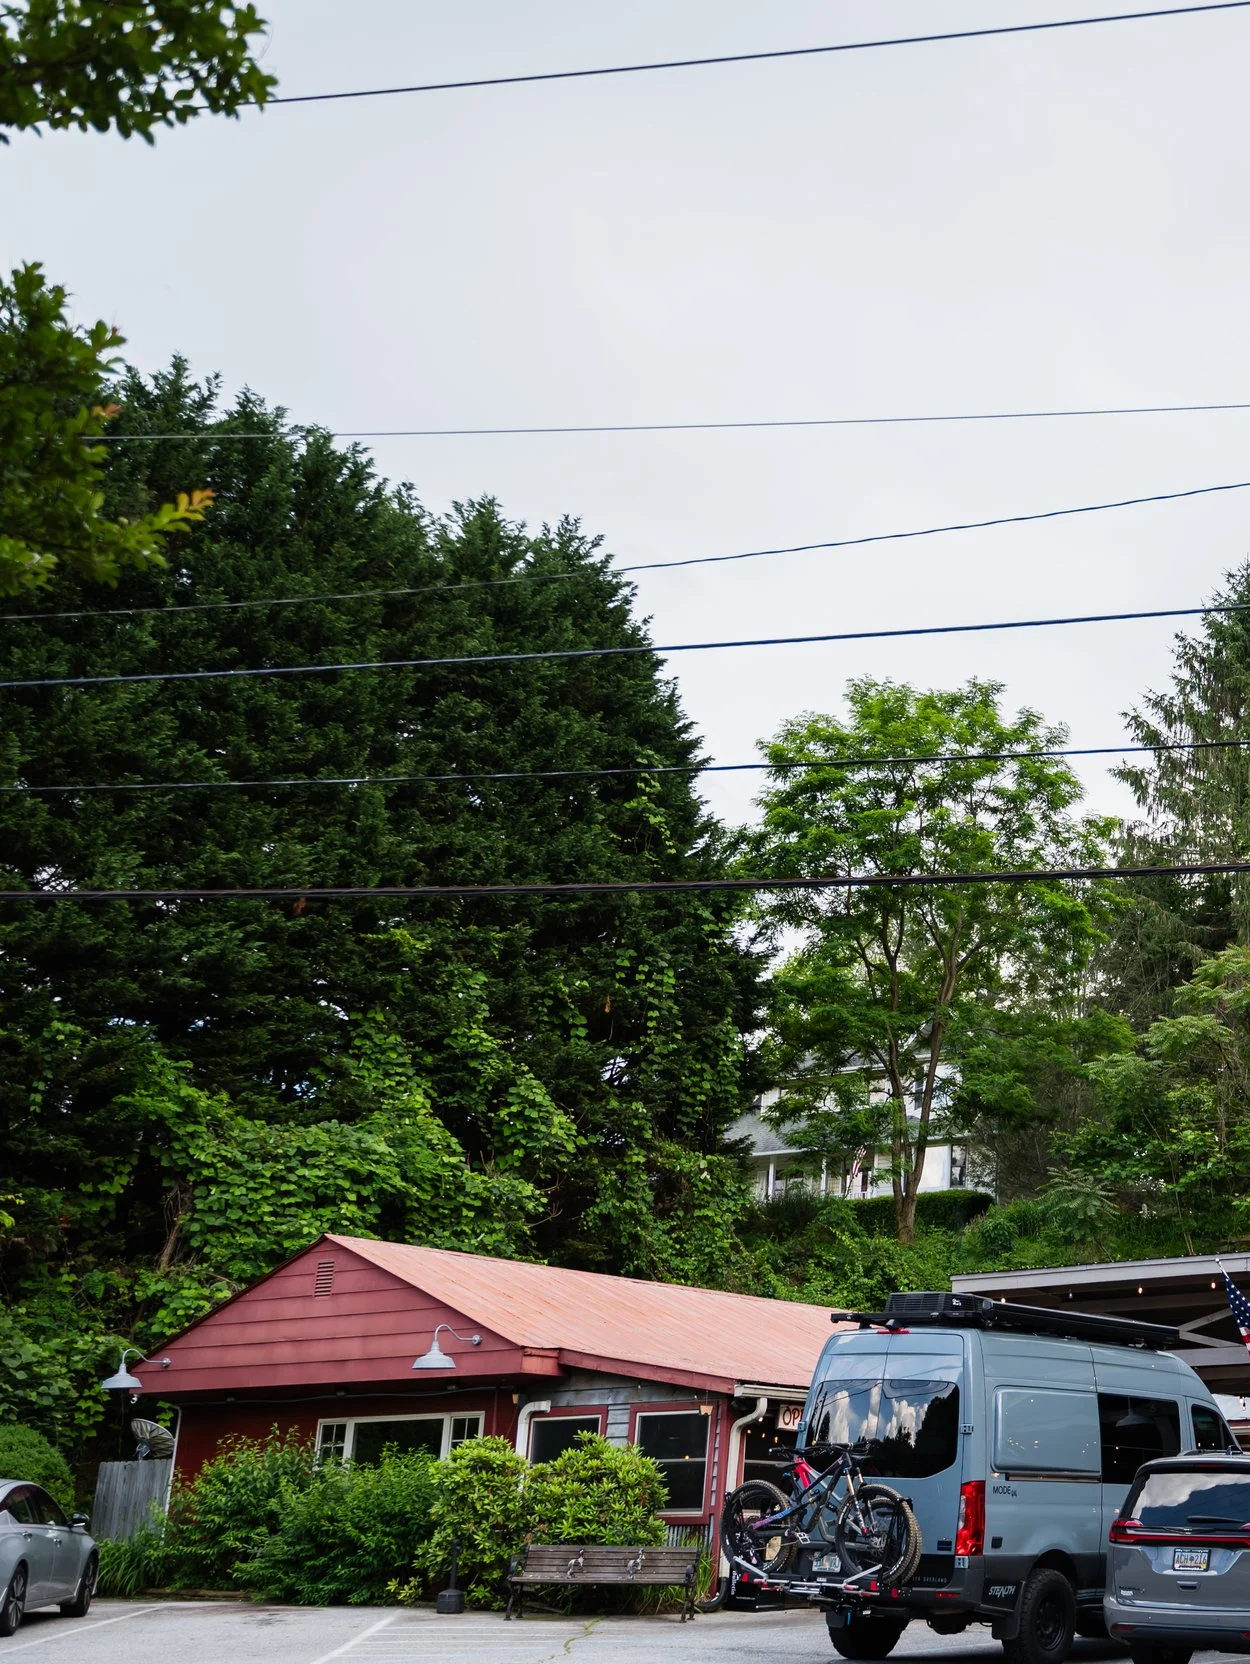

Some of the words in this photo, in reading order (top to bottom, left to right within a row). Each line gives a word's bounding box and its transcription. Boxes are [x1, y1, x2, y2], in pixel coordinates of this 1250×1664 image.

[783, 1406, 804, 1426] OP
[1176, 1553, 1189, 1564] ACH
[988, 1585, 1016, 1598] STEALTH
